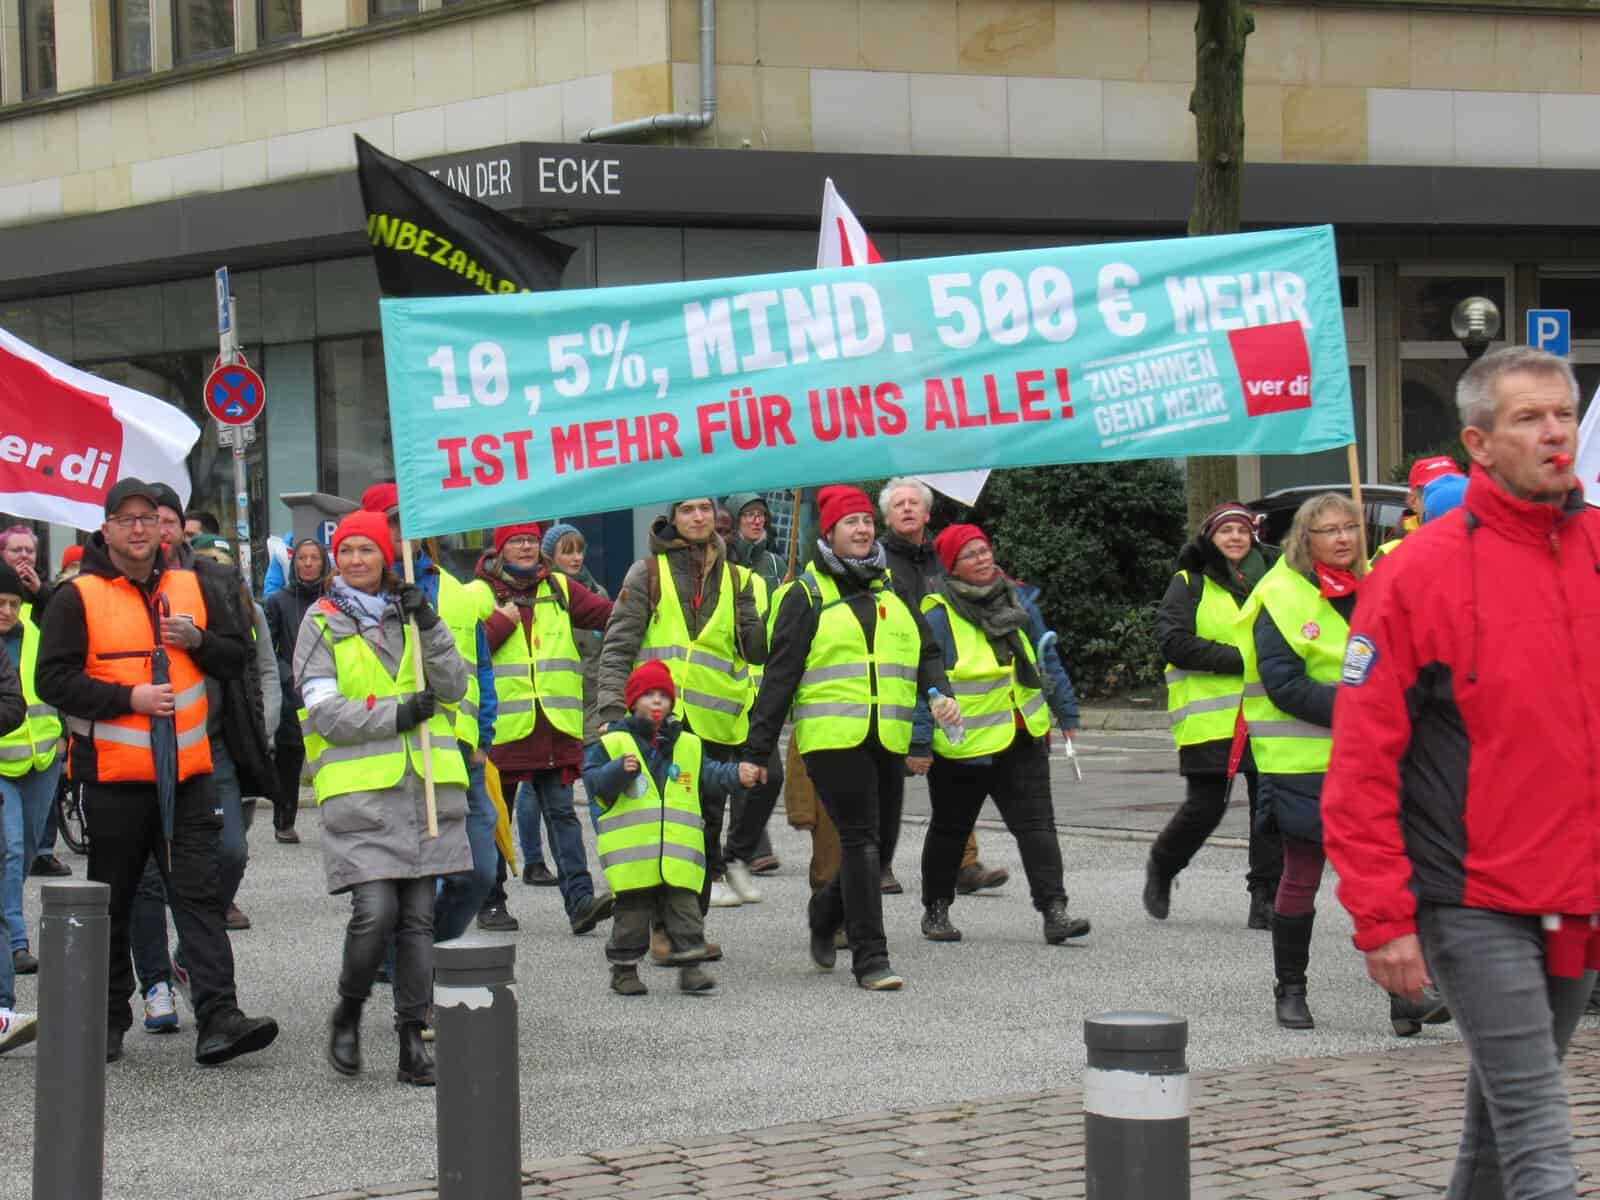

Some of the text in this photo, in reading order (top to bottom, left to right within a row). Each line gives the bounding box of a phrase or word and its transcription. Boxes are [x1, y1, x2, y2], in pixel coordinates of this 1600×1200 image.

[447, 158, 621, 198] AN DER ECKE
[683, 281, 913, 379] MIND.
[928, 266, 1078, 349] 500
[1096, 262, 1148, 337] €
[1164, 271, 1313, 334] MEHR
[1538, 317, 1560, 349] P
[1082, 346, 1219, 401] ZUSAMMEN
[437, 368, 1074, 490] IST MEHR FÜR UNS ALLE!
[1093, 382, 1228, 435] GEHT MEHR
[0, 433, 112, 489] er.di
[324, 521, 337, 545] P
